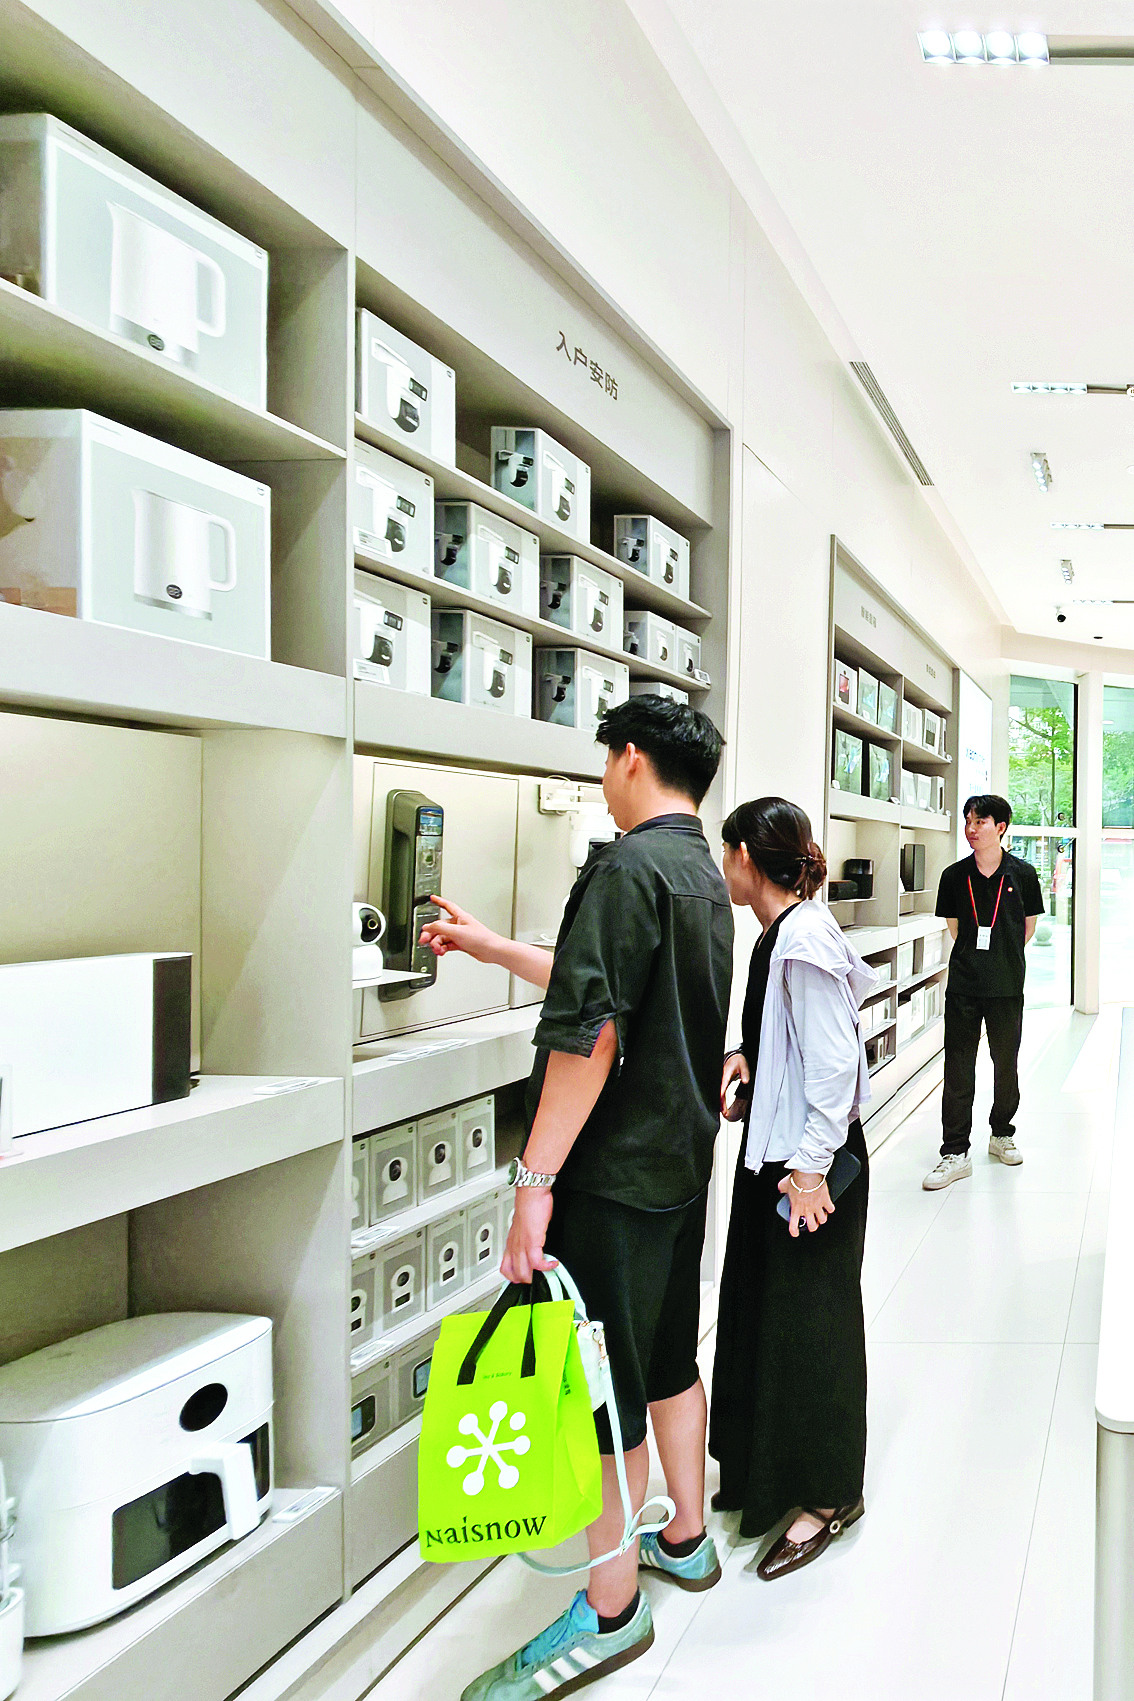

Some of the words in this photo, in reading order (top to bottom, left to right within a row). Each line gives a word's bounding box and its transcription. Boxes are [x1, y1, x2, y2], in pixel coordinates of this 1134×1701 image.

[556, 330, 618, 400] 入户安防
[425, 1515, 548, 1548] Naisnow
